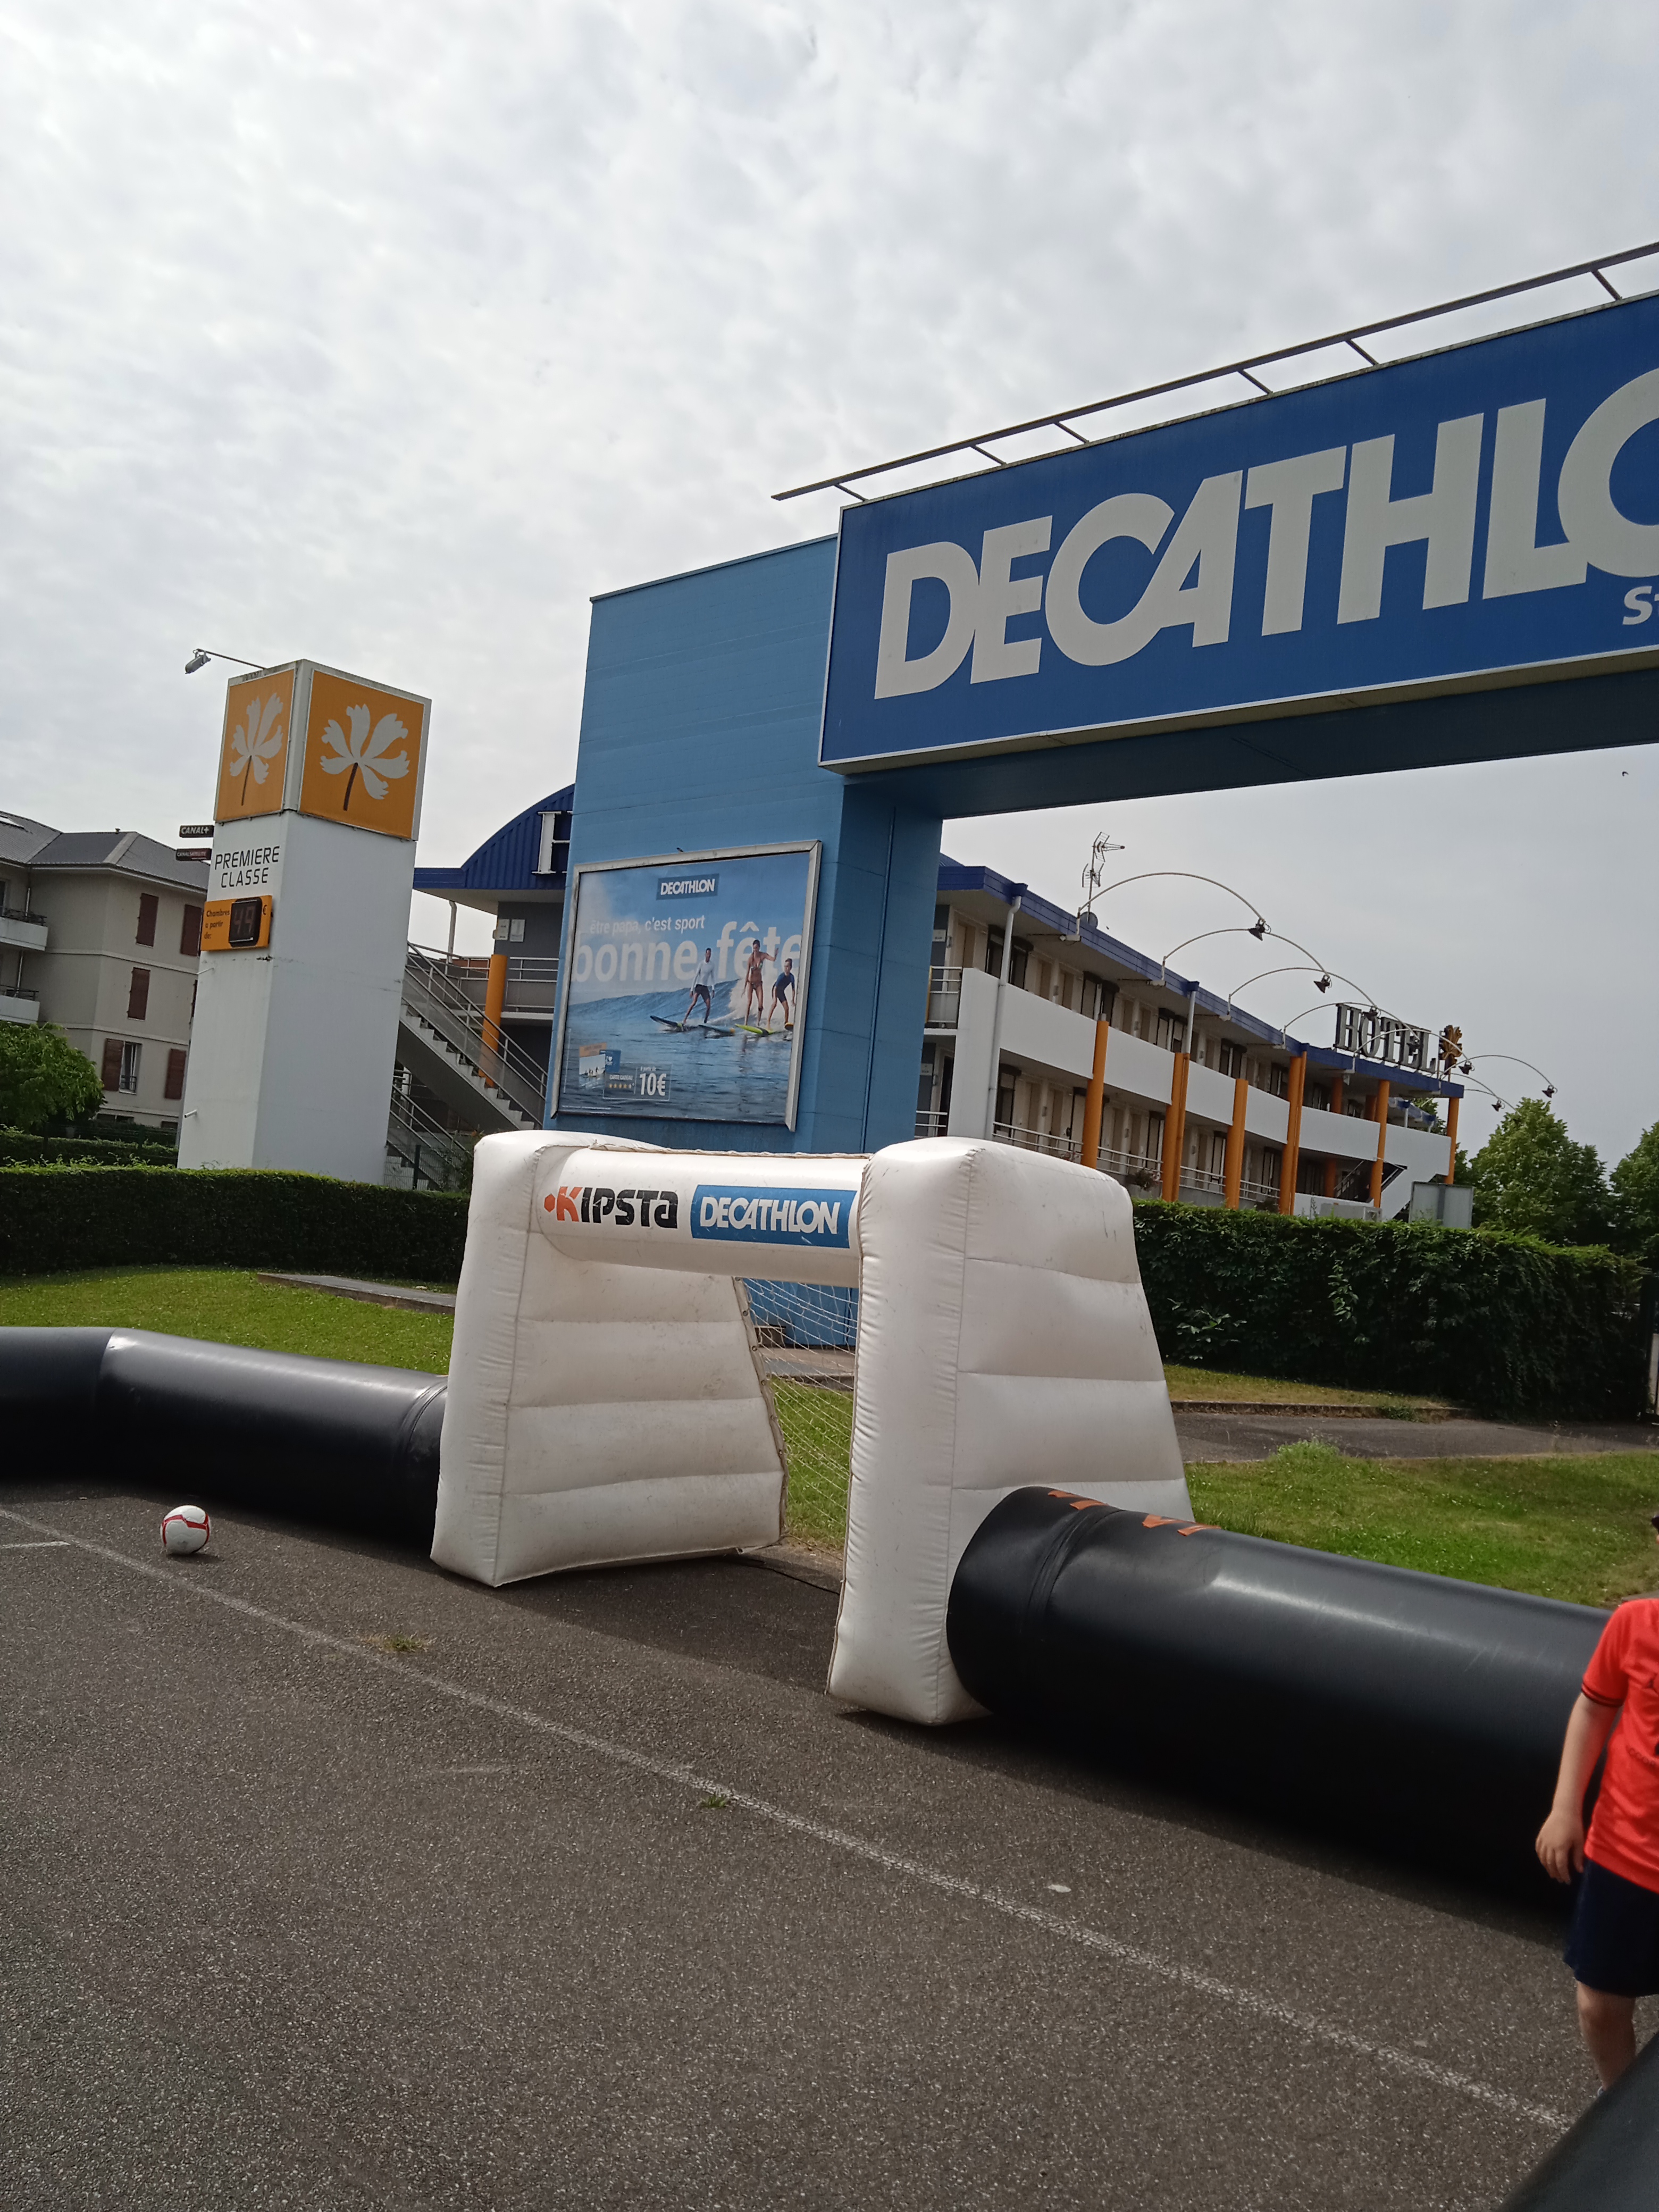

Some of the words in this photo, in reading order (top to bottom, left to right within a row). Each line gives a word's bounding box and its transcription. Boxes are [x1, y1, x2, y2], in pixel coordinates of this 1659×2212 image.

[1622, 585, 1659, 625] S
[214, 845, 280, 870] PREMIERE
[221, 867, 269, 888] CLASSE
[660, 878, 715, 895] DECATHLON
[206, 908, 230, 917] Chambres
[590, 920, 610, 934] être
[645, 917, 672, 931] c'est
[675, 915, 706, 934] sport
[574, 932, 698, 983] bonne
[716, 921, 802, 984] fête
[1333, 1003, 1436, 1074] HOTEL
[639, 1073, 667, 1096] 10€
[700, 1197, 841, 1235] DECATHLON
